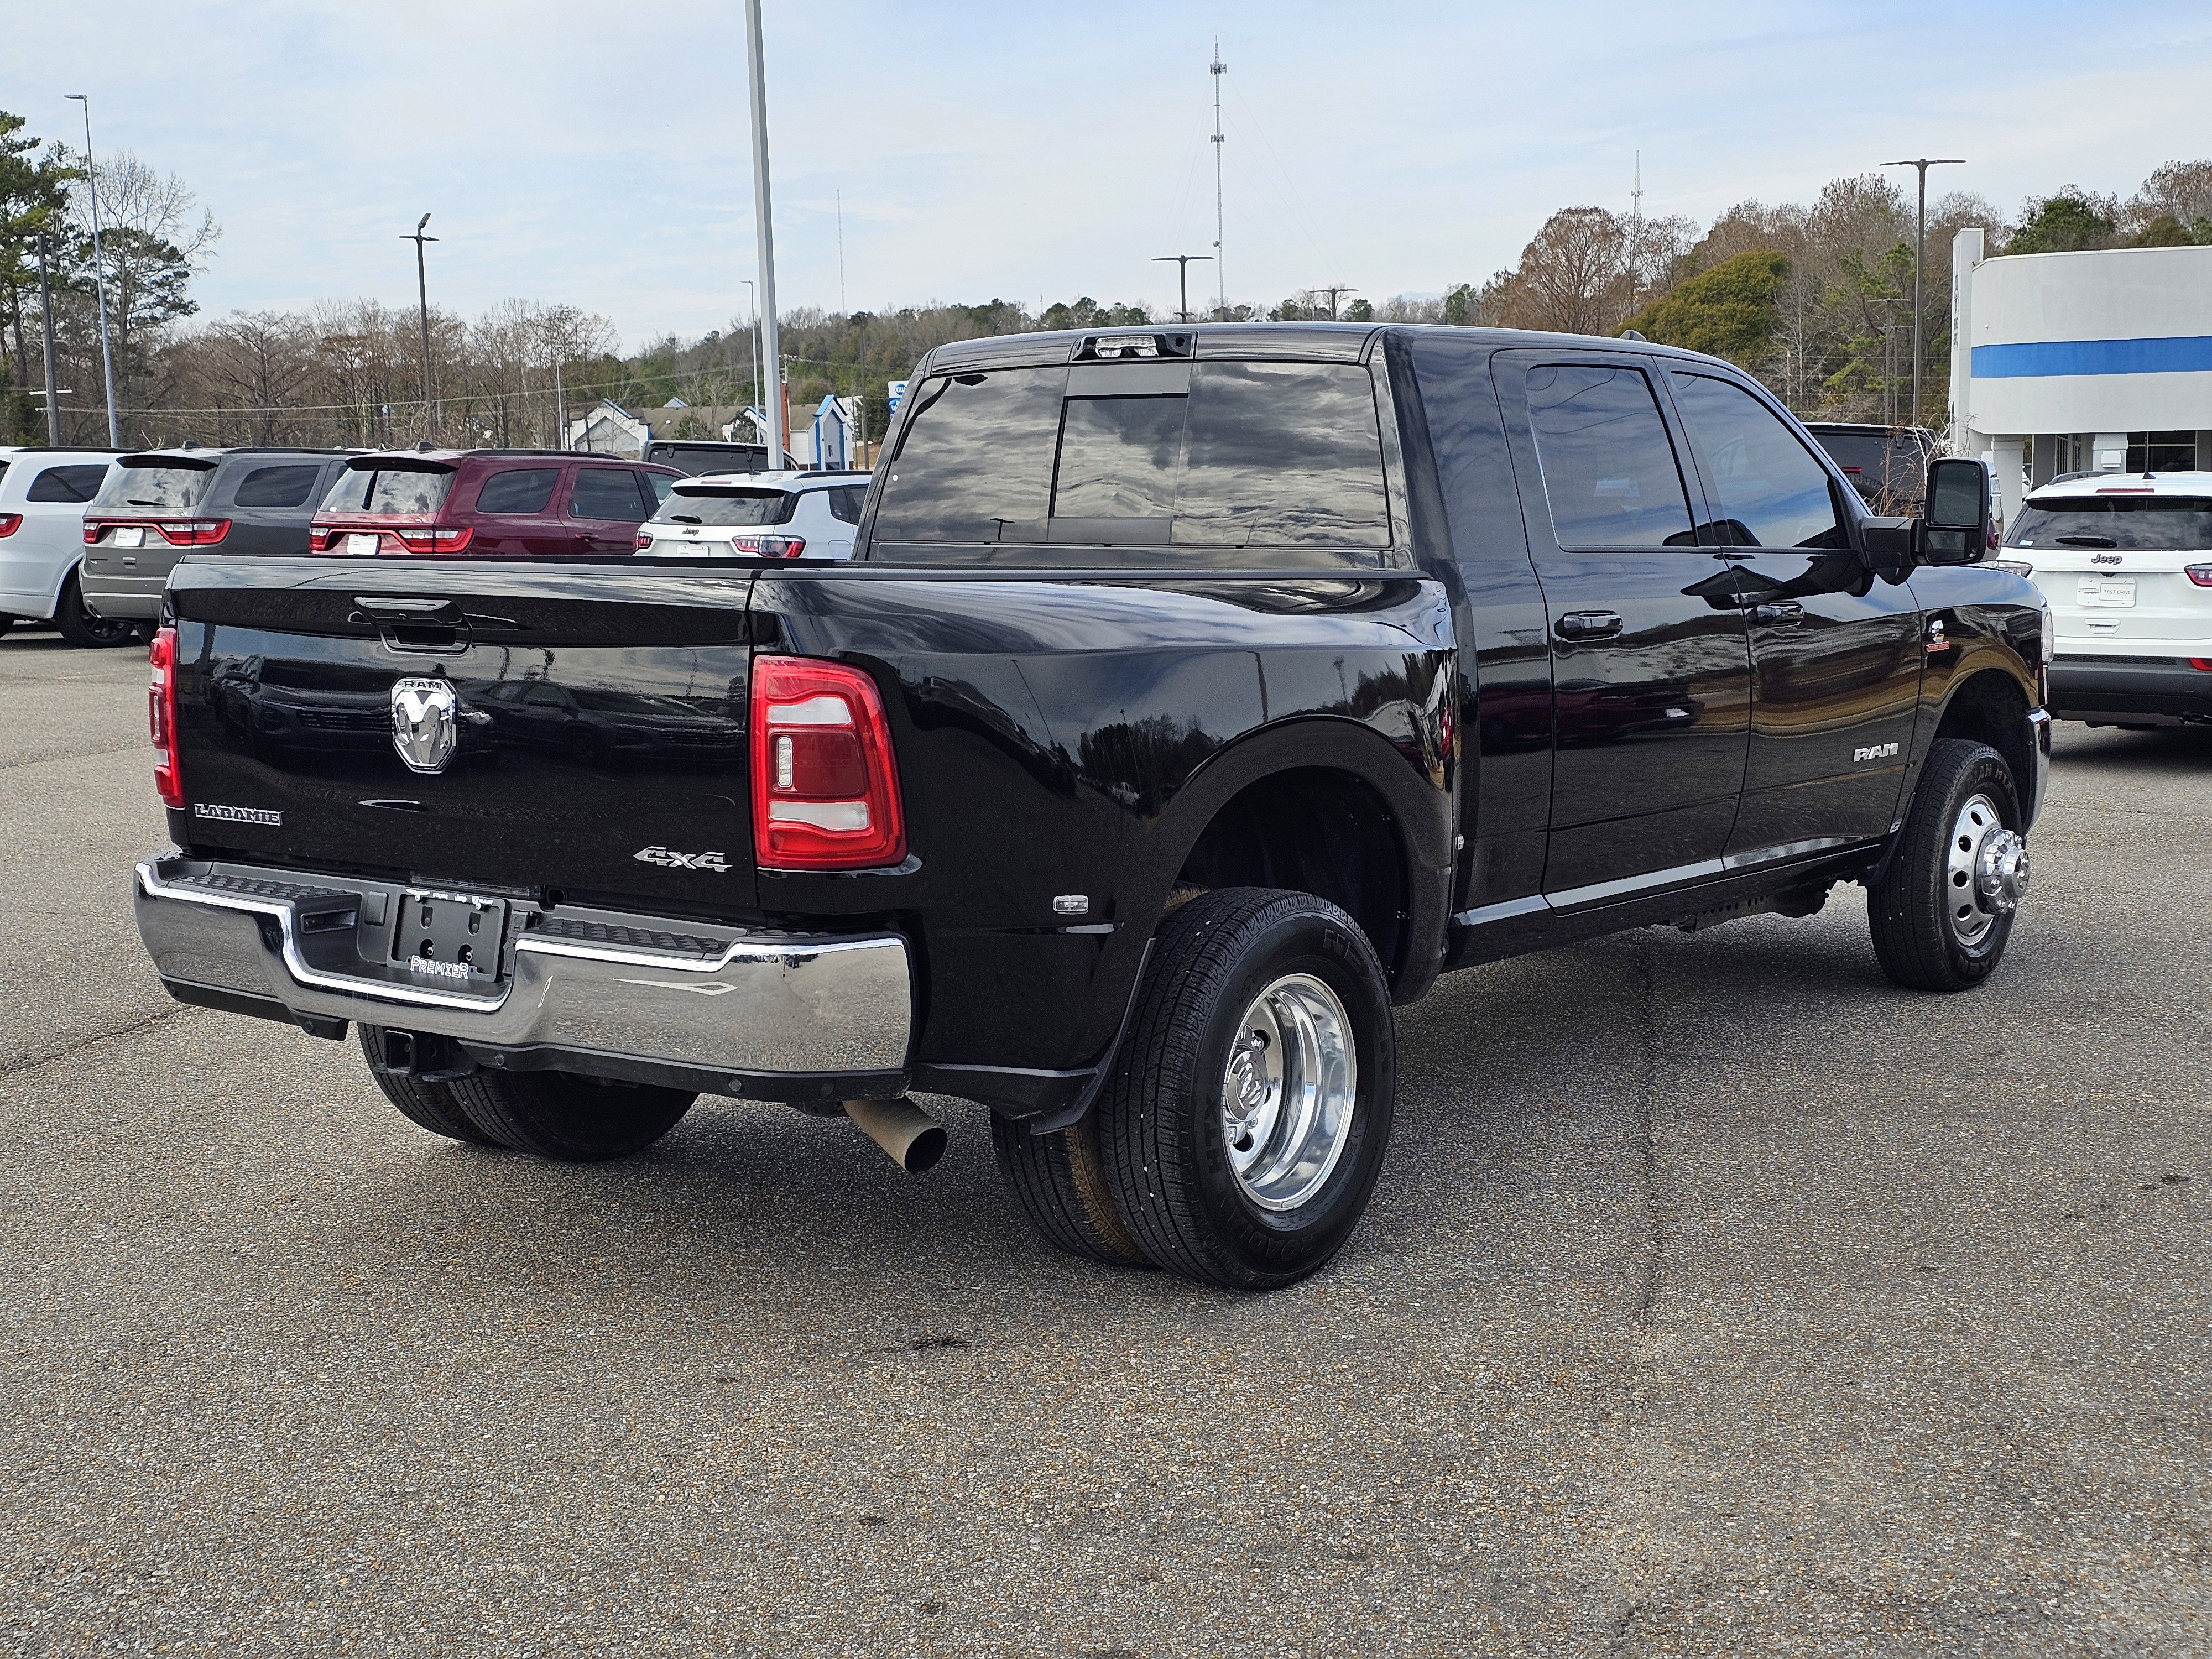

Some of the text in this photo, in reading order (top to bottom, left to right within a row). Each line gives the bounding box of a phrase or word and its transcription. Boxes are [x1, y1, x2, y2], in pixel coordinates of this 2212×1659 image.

[682, 527, 699, 536] Jeep
[2091, 554, 2122, 565] Jeep
[403, 680, 442, 690] RAM
[1853, 742, 1898, 762] RAM
[194, 803, 284, 826] LARAMIE
[410, 954, 469, 979] PREMIER
[1204, 1092, 1223, 1174] HTX
